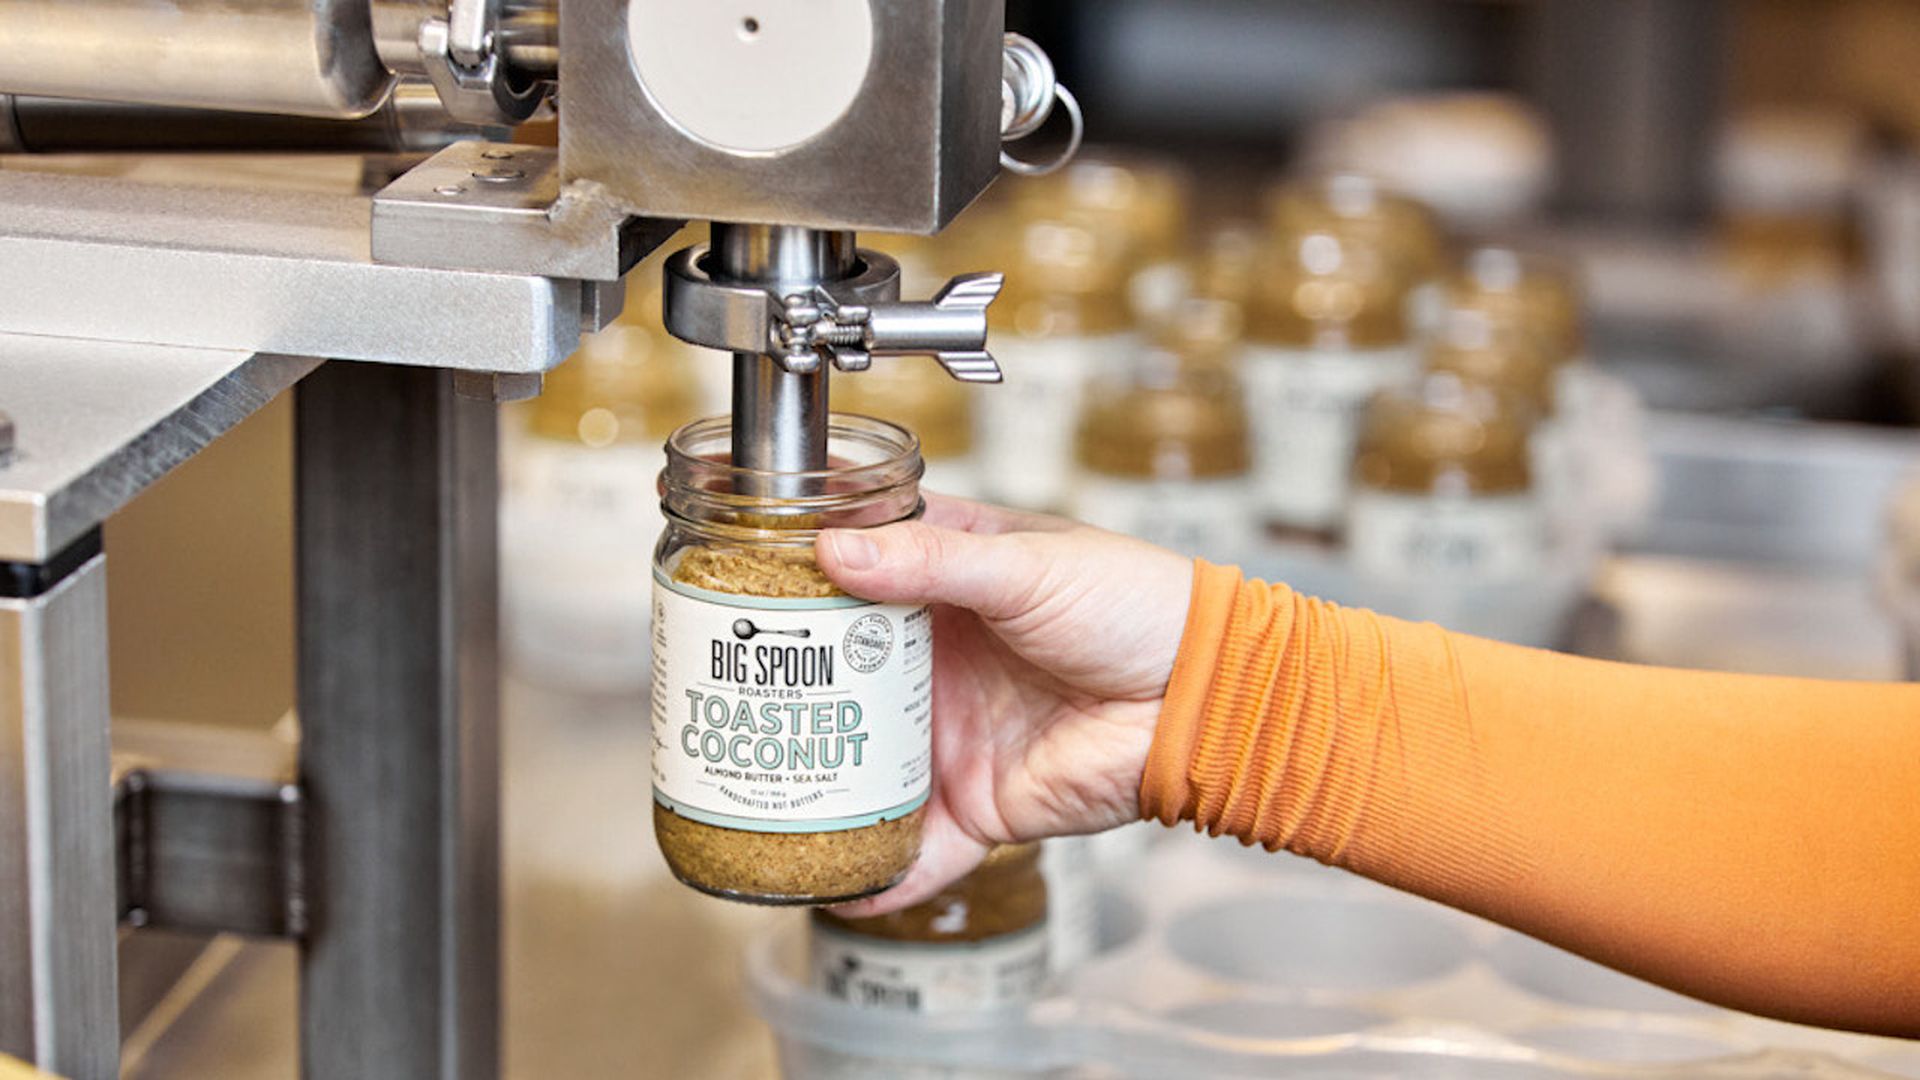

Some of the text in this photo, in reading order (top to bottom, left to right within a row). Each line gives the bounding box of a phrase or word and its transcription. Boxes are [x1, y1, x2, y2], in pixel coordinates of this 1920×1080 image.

[711, 639, 747, 684] BIG
[755, 645, 833, 687] SPOON
[738, 686, 804, 700] ROASTERS
[685, 689, 863, 736] TOASTED
[681, 723, 868, 771] COCONUT
[704, 765, 838, 783] ALMOND BUTTER SEA SALT
[720, 784, 769, 810] HANDCRAFTED
[790, 789, 824, 809] BUTTERS
